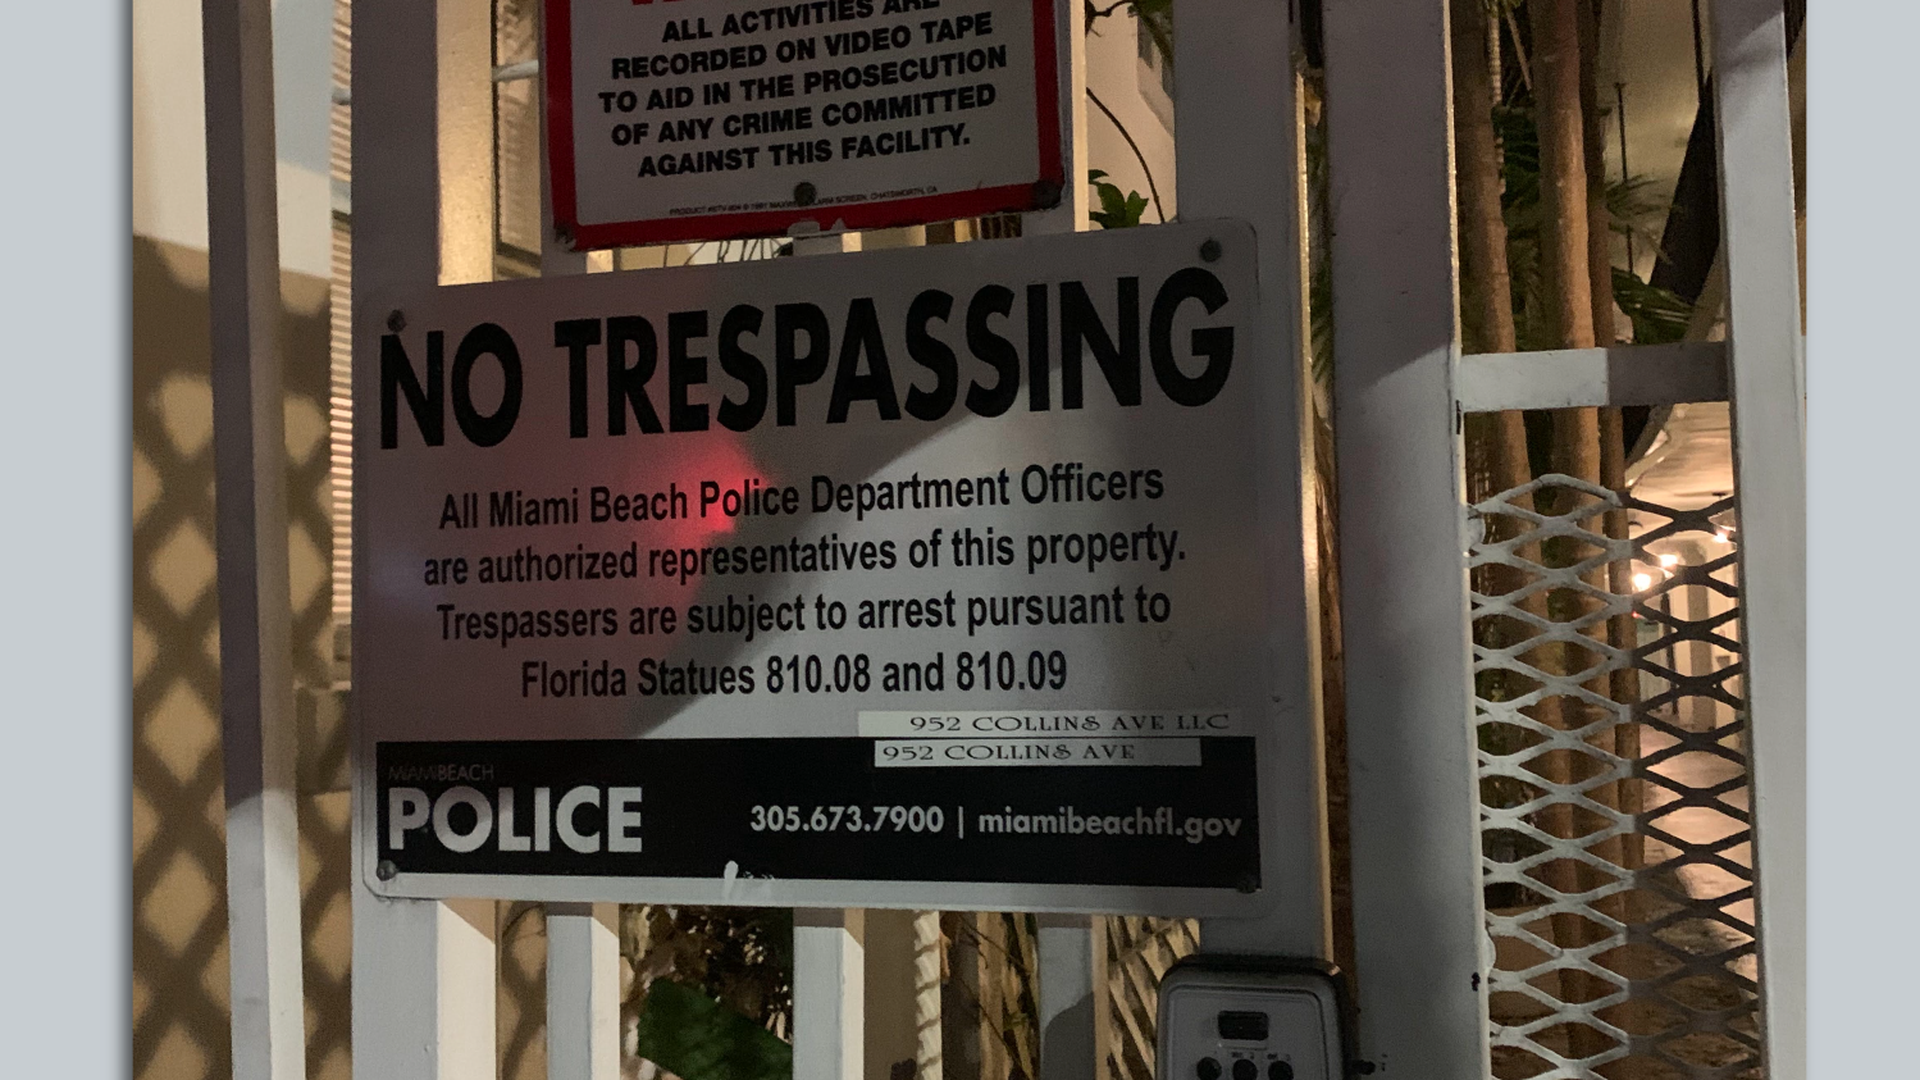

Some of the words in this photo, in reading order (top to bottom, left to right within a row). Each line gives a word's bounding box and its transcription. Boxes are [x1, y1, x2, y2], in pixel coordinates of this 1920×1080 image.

[612, 45, 767, 80] RECORDED
[777, 38, 816, 62] ON
[825, 26, 911, 57] VIDEO
[920, 11, 993, 43] TAPE
[662, 18, 712, 43] ALL
[722, 0, 876, 36] ACTIVITIES
[598, 91, 637, 113] TO
[646, 87, 694, 110] AID
[704, 82, 730, 105] IN
[741, 75, 794, 100] THE
[804, 46, 1007, 94] PROSECUTION
[611, 123, 649, 146] OF
[658, 117, 714, 143] ANY
[723, 108, 812, 137] CRIME
[823, 84, 996, 127] COMMITTED
[638, 147, 759, 178] AGAINST
[768, 139, 832, 166] THIS
[842, 123, 970, 157] FACILITY.
[380, 322, 523, 449] NO
[554, 267, 1235, 438] TRESPASSING
[439, 493, 478, 529] All
[490, 488, 578, 527] Miami
[591, 483, 687, 523] Beach
[701, 479, 799, 520] Police
[811, 468, 1010, 521] Department
[1021, 462, 1164, 504] Officers
[424, 558, 468, 586] are
[478, 541, 637, 583] authorized
[649, 537, 897, 585] representatives
[909, 528, 942, 568] of
[951, 527, 1014, 566] this
[1028, 523, 1185, 574] property.
[437, 604, 618, 648] Trespassers
[629, 607, 676, 635] are
[687, 594, 805, 642] subject
[815, 594, 846, 630] to
[858, 590, 956, 629] arrest
[968, 586, 1124, 636] pursuant
[1134, 585, 1171, 623] to
[522, 660, 626, 697] Florida
[638, 658, 755, 697] Statues
[767, 653, 870, 693] 810.08
[883, 652, 944, 692] and
[957, 650, 1067, 691] 810.09
[884, 746, 932, 759] 952
[945, 744, 1071, 759] COLLINS
[1083, 745, 1134, 758] AVE
[911, 717, 960, 731] 952
[972, 716, 1100, 731] COLLINS
[1112, 715, 1164, 730] AVE
[1178, 714, 1228, 729] LLC
[389, 785, 642, 853] POLICE
[751, 804, 944, 832] 305.673.7900
[979, 806, 1241, 843] miamibeachfl.gov
